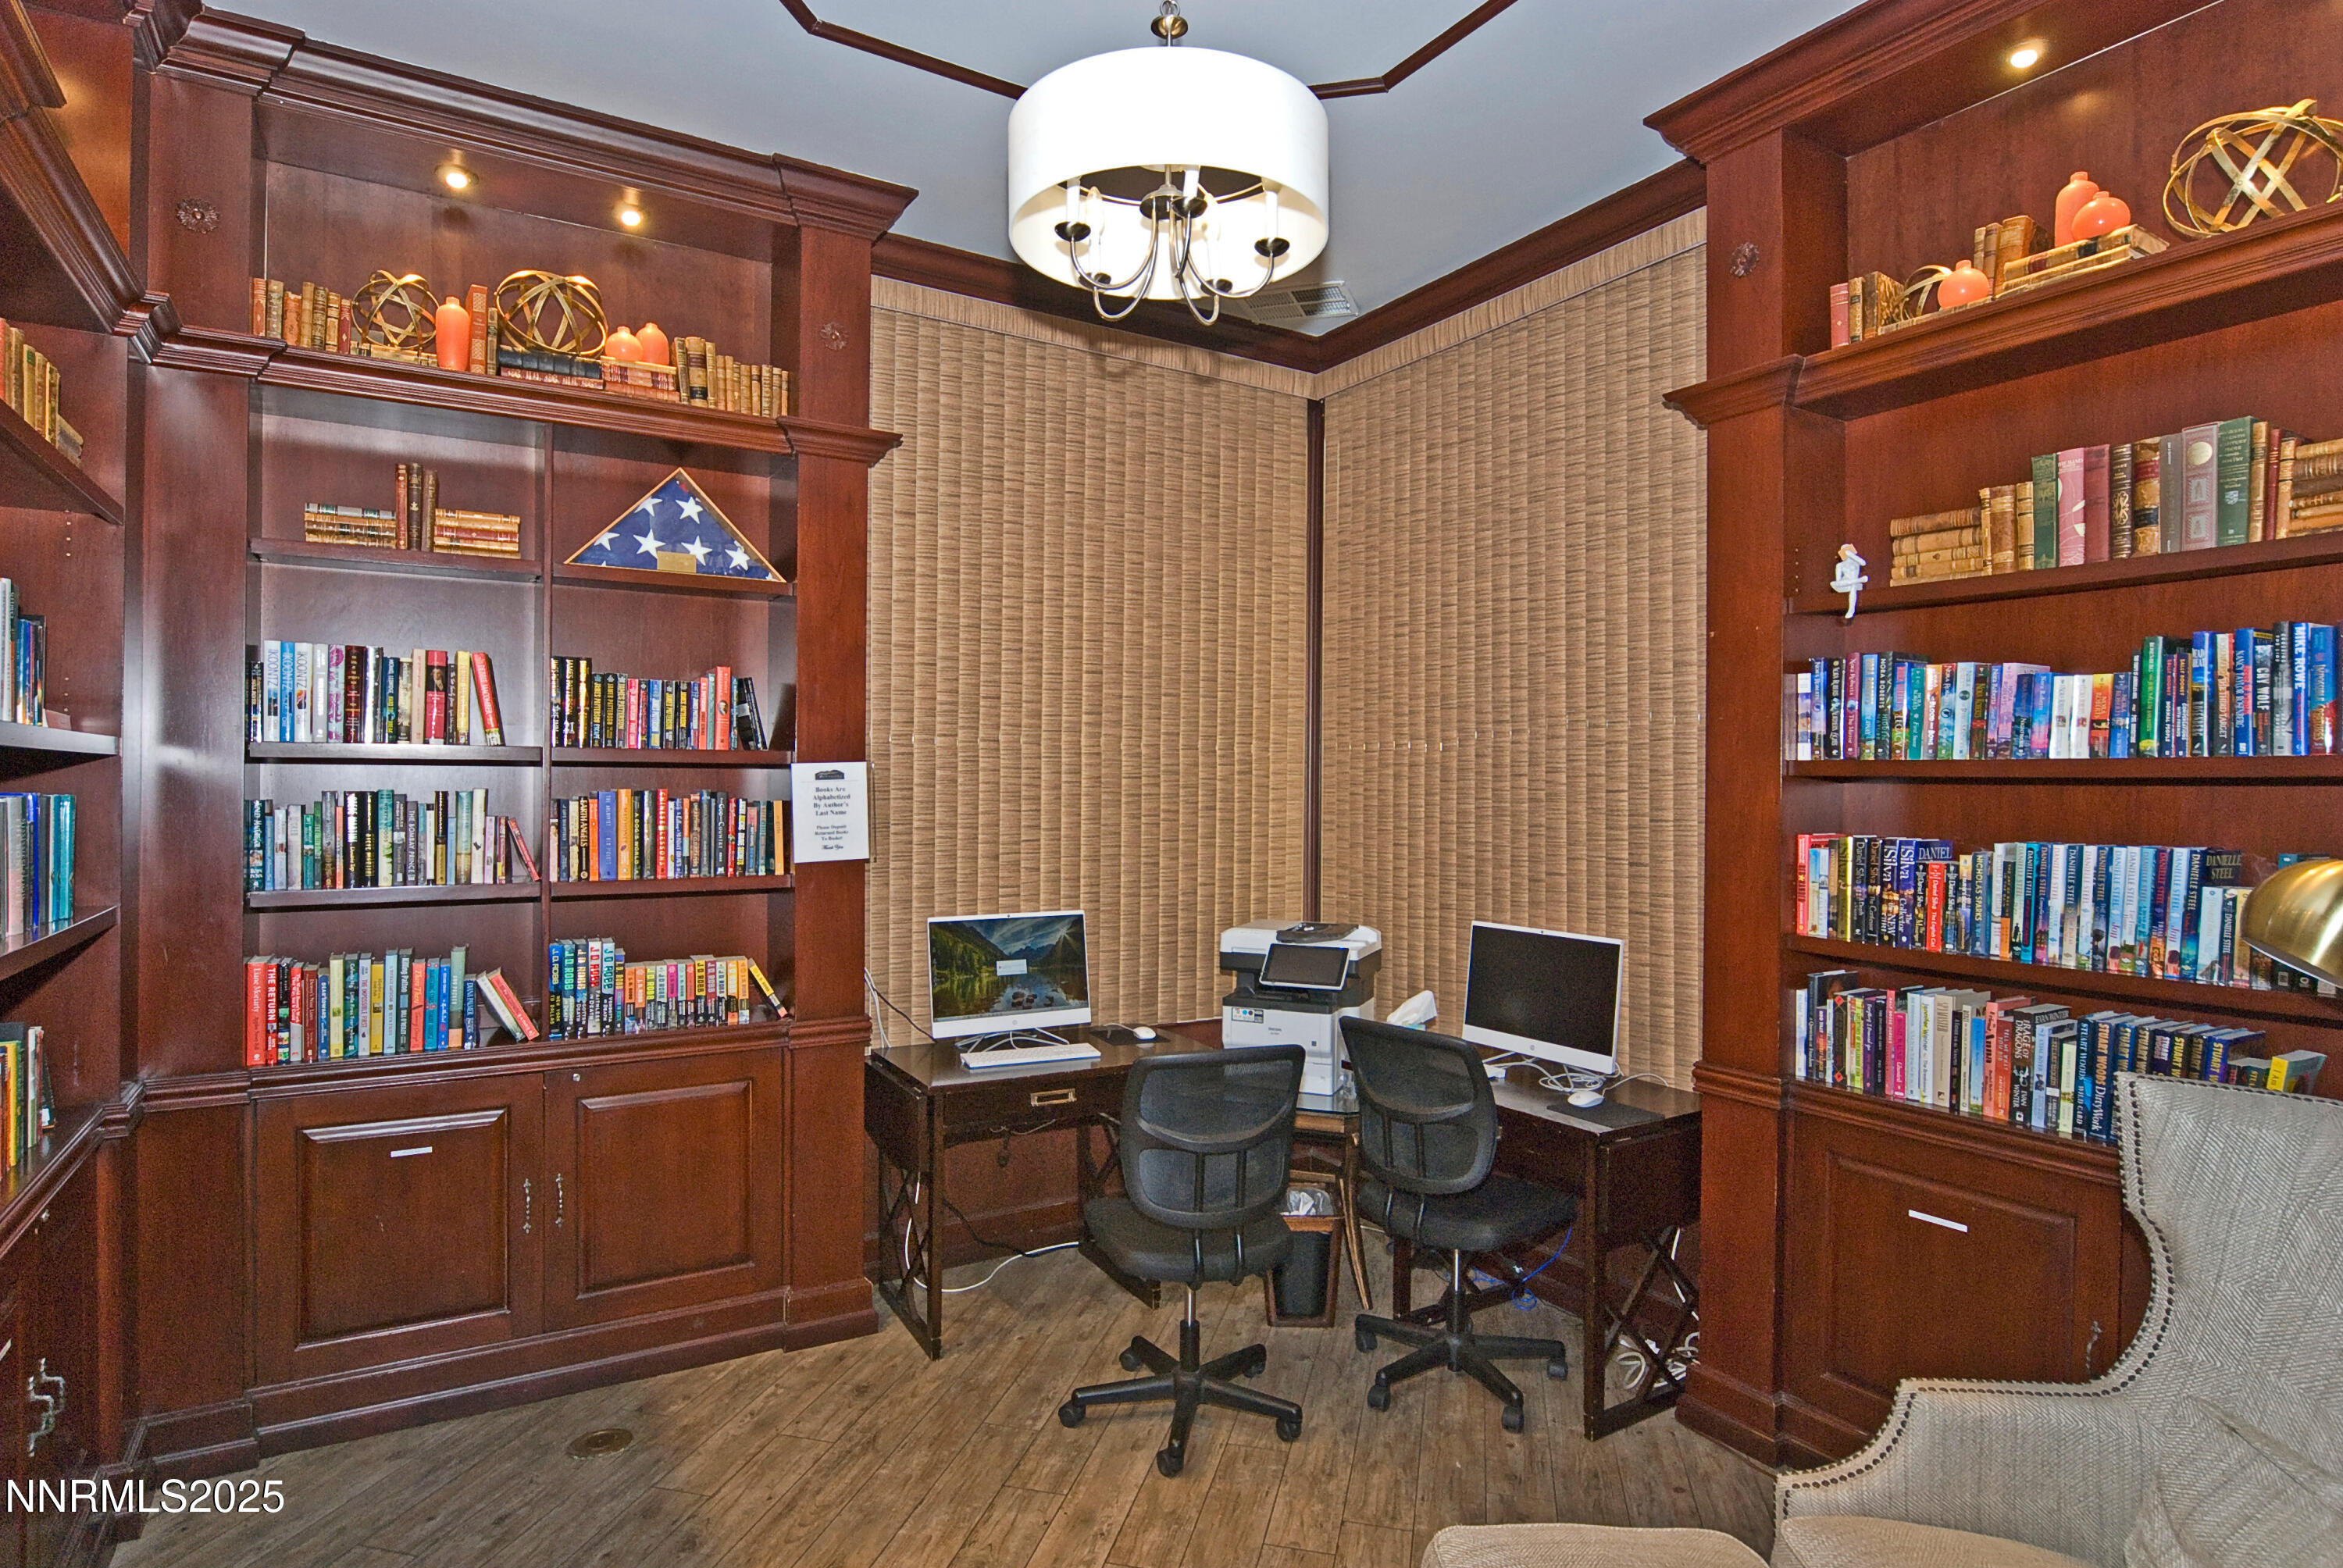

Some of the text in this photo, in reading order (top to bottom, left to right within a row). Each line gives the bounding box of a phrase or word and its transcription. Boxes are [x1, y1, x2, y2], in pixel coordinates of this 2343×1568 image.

[266, 652, 279, 687] KOONTZ
[281, 654, 294, 690] KOONTZ
[296, 654, 308, 689] KOONTZ
[2295, 626, 2306, 690] MIKE ROWE
[2256, 686, 2270, 711] WOLF
[1882, 849, 1898, 882] Silva
[1899, 849, 1915, 880] Silva
[1919, 847, 1952, 860] DANIEL
[2127, 851, 2138, 885] DANIELLE
[2158, 852, 2167, 884] DANIELLE
[2206, 854, 2241, 867] DANIELLE
[2039, 846, 2049, 896] DANIELLE STEEL
[2066, 850, 2077, 905] DANIELLE STEEL
[2096, 850, 2107, 901] DANIELLE STEEL
[2111, 851, 2122, 907] DANIELLE STEEL
[2172, 851, 2183, 909] DANIELLE STEEL
[2187, 853, 2200, 911] DANIELLE STEEL
[2210, 868, 2234, 879] STEEL
[1898, 898, 1908, 933] Collector
[253, 968, 262, 985] Liane
[564, 968, 575, 991] ROBB
[576, 966, 587, 990] ROBB
[603, 965, 614, 990] ROBB
[646, 982, 655, 1000] ROBB
[252, 985, 262, 1013] Moriarty
[267, 968, 276, 1021] THE RETURN
[2014, 1020, 2023, 1059] DRAGONS
[2022, 1024, 2031, 1047] RAGE
[2098, 1023, 2109, 1054] STUART
[2119, 1027, 2131, 1059] STUART
[2137, 1030, 2149, 1060] STUART
[2161, 1036, 2170, 1061] STUART
[2078, 1052, 2087, 1080] WOODS
[2173, 1036, 2185, 1067] STUART
[2191, 1038, 2204, 1070] STUART
[2210, 1042, 2224, 1073] STUART
[2095, 1056, 2107, 1085] WOODS
[2013, 1084, 2021, 1108] WINTER
